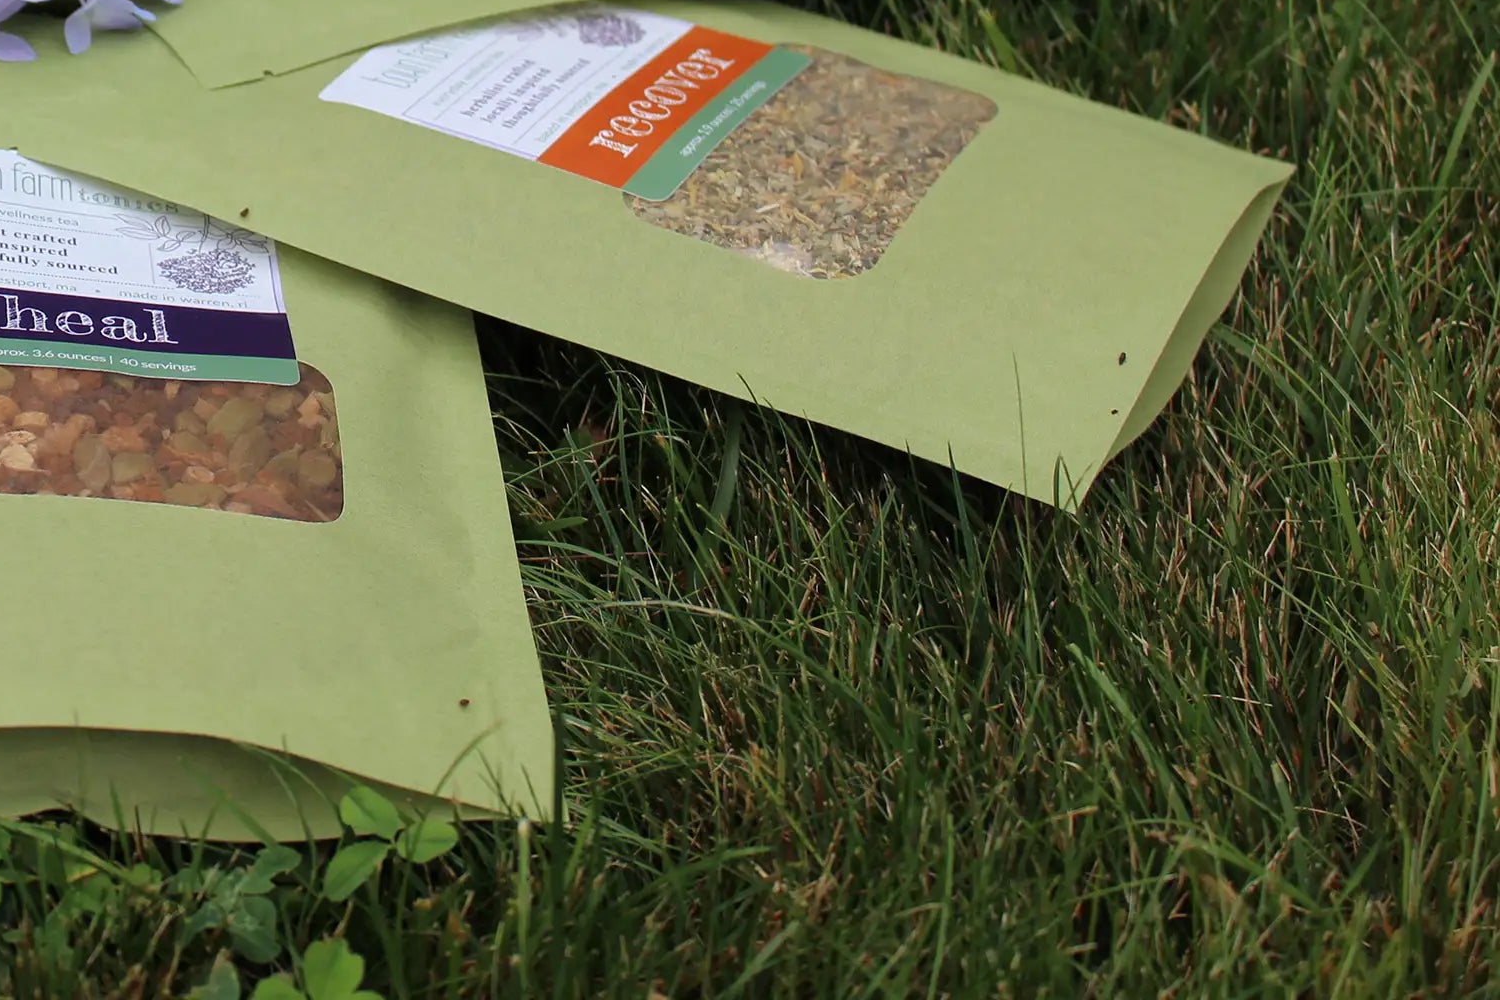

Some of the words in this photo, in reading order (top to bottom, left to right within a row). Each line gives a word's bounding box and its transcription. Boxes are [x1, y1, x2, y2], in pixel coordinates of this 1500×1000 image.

[588, 48, 736, 158] recover
[11, 161, 73, 202] farm
[57, 216, 79, 227] tea
[13, 230, 78, 246] crafted
[46, 259, 118, 275] sourced
[55, 283, 77, 292] ma
[119, 289, 158, 301] made
[162, 293, 176, 302] in
[179, 297, 234, 309] warren,
[237, 300, 248, 309] ri
[32, 348, 55, 359] 3.6
[57, 352, 107, 363] ounces
[119, 357, 139, 367] 40
[141, 359, 197, 373] servings
